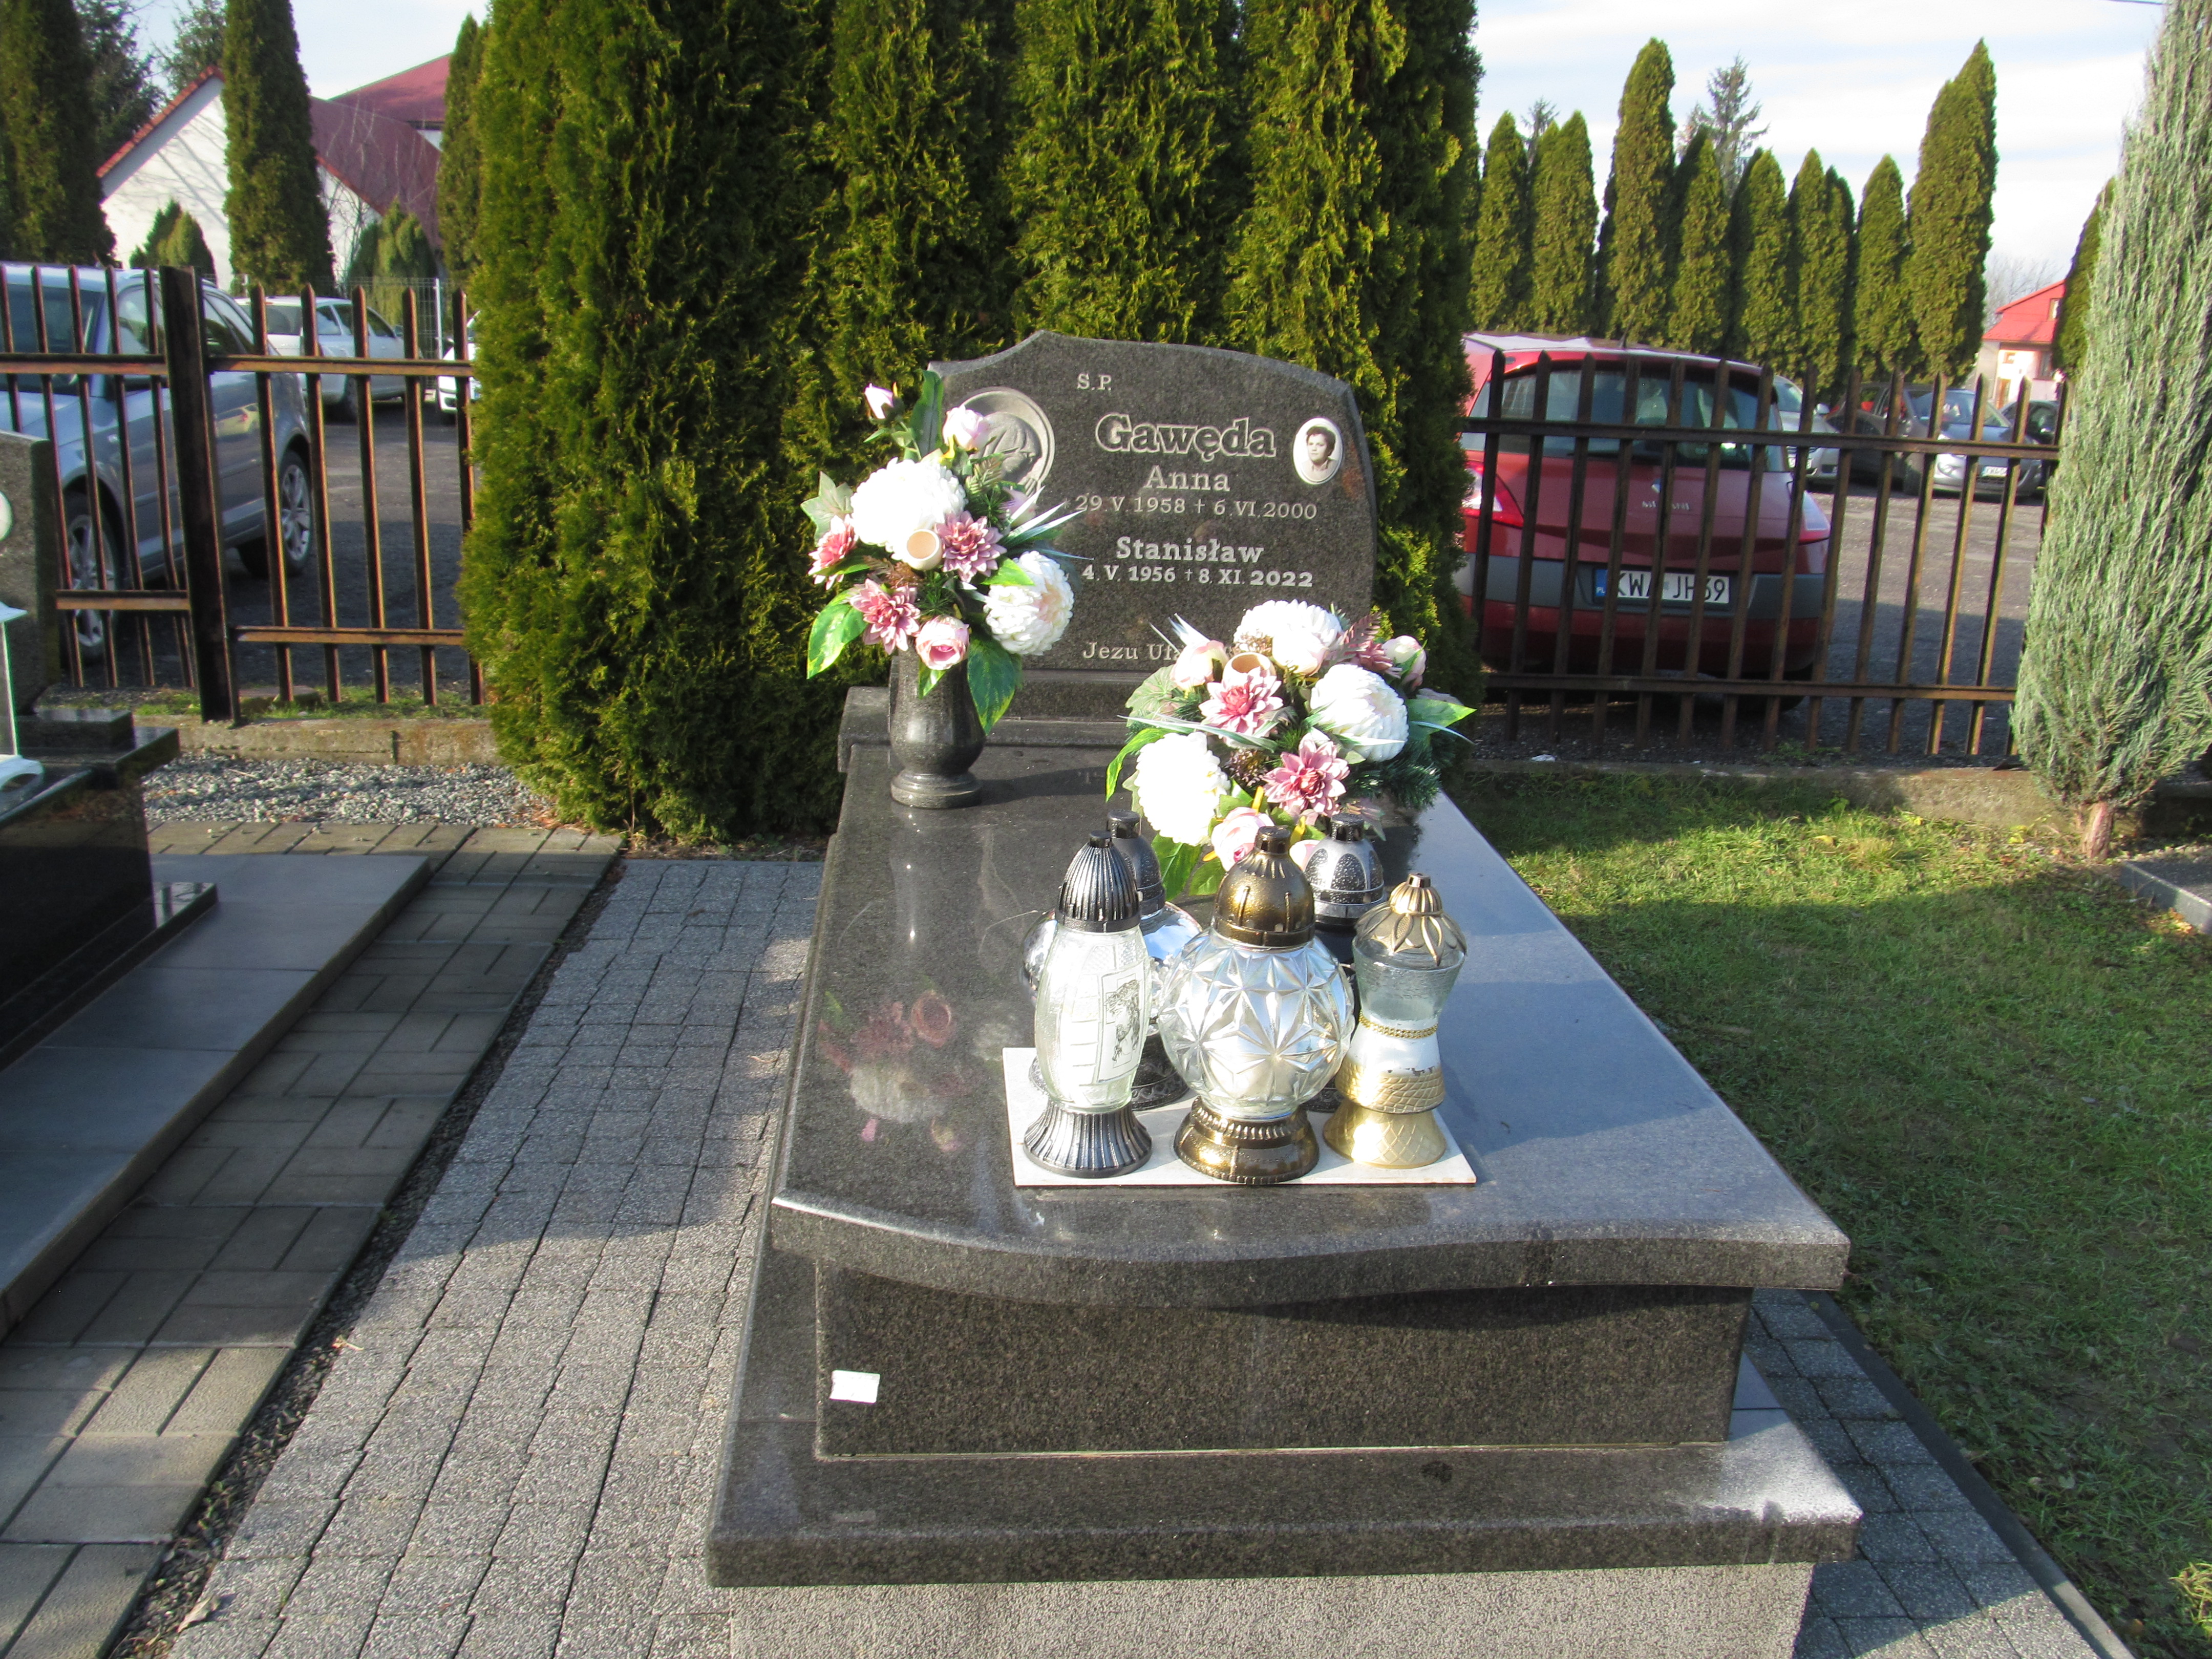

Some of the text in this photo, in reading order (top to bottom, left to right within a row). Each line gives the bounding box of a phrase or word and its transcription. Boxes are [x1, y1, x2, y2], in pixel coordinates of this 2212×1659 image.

[1095, 412, 1277, 462] Gawęda
[1142, 465, 1230, 492] Anna
[1116, 536, 1264, 563] Stanisław
[1082, 642, 1138, 660] Jezu
